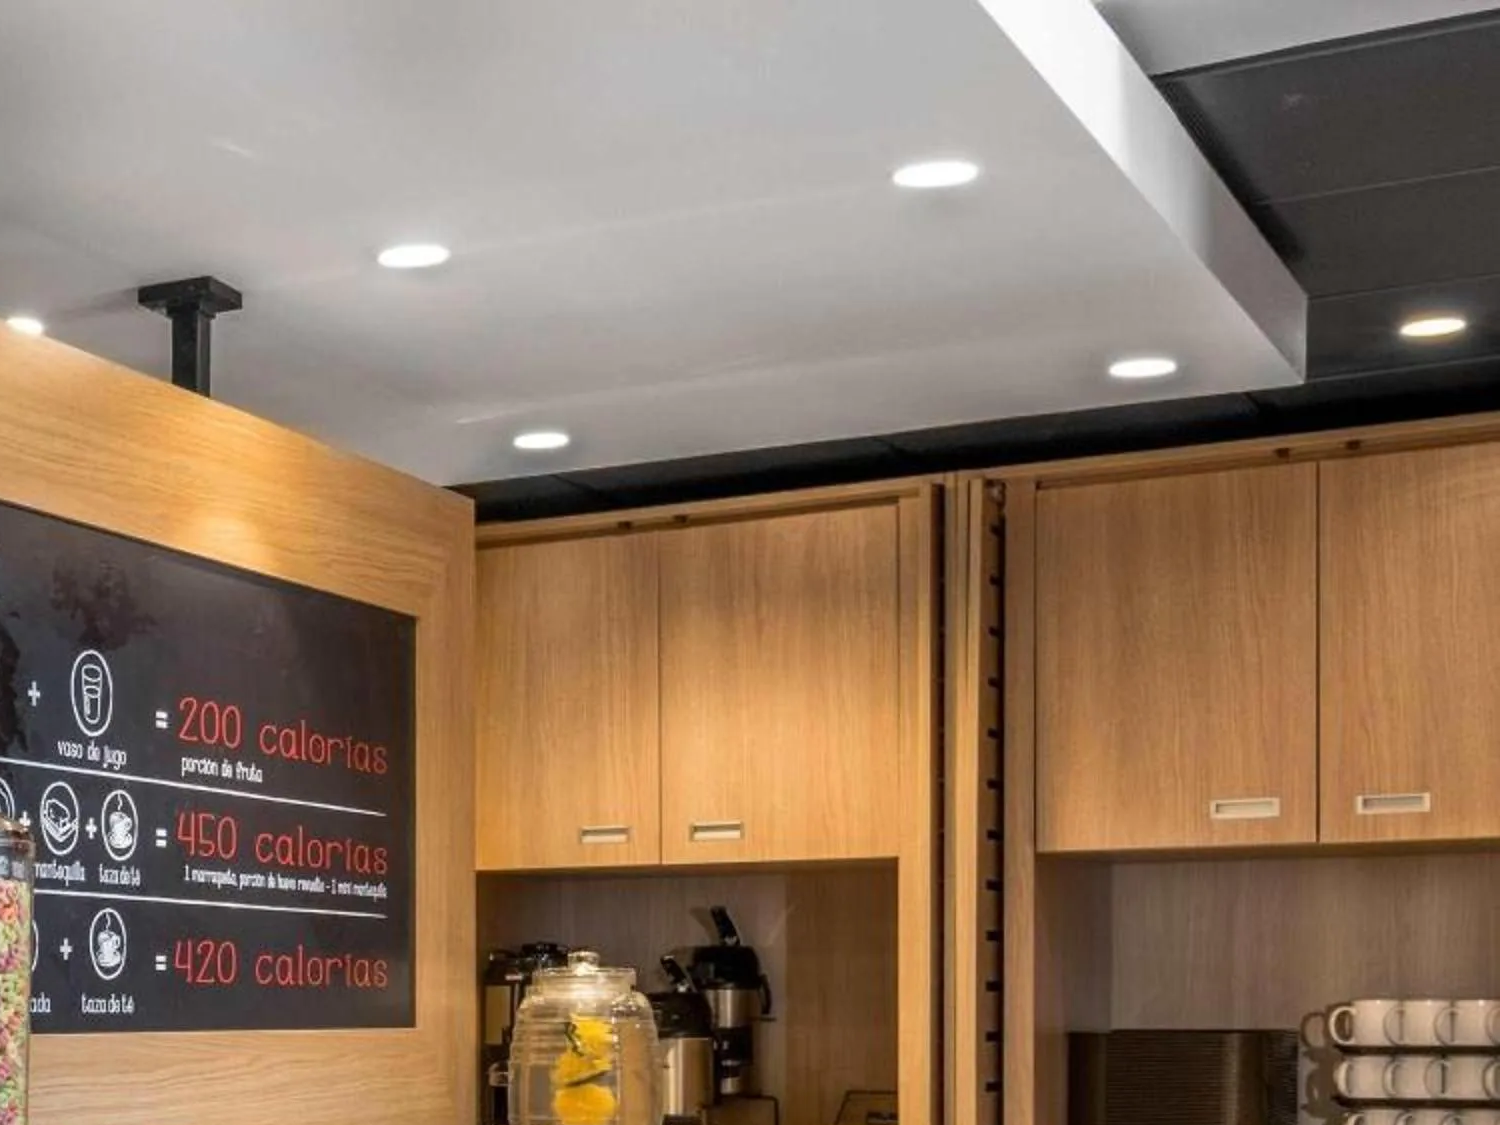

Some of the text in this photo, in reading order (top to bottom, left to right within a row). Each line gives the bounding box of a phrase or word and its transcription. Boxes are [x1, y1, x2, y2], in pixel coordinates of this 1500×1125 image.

[178, 696, 242, 749] 200
[57, 740, 127, 770] vaso de jugo
[221, 758, 233, 779] de
[235, 760, 264, 783] fruta
[176, 811, 238, 860] 450
[184, 864, 190, 881] 1
[173, 939, 237, 984] 420
[81, 991, 107, 1014] taza
[108, 993, 120, 1013] de
